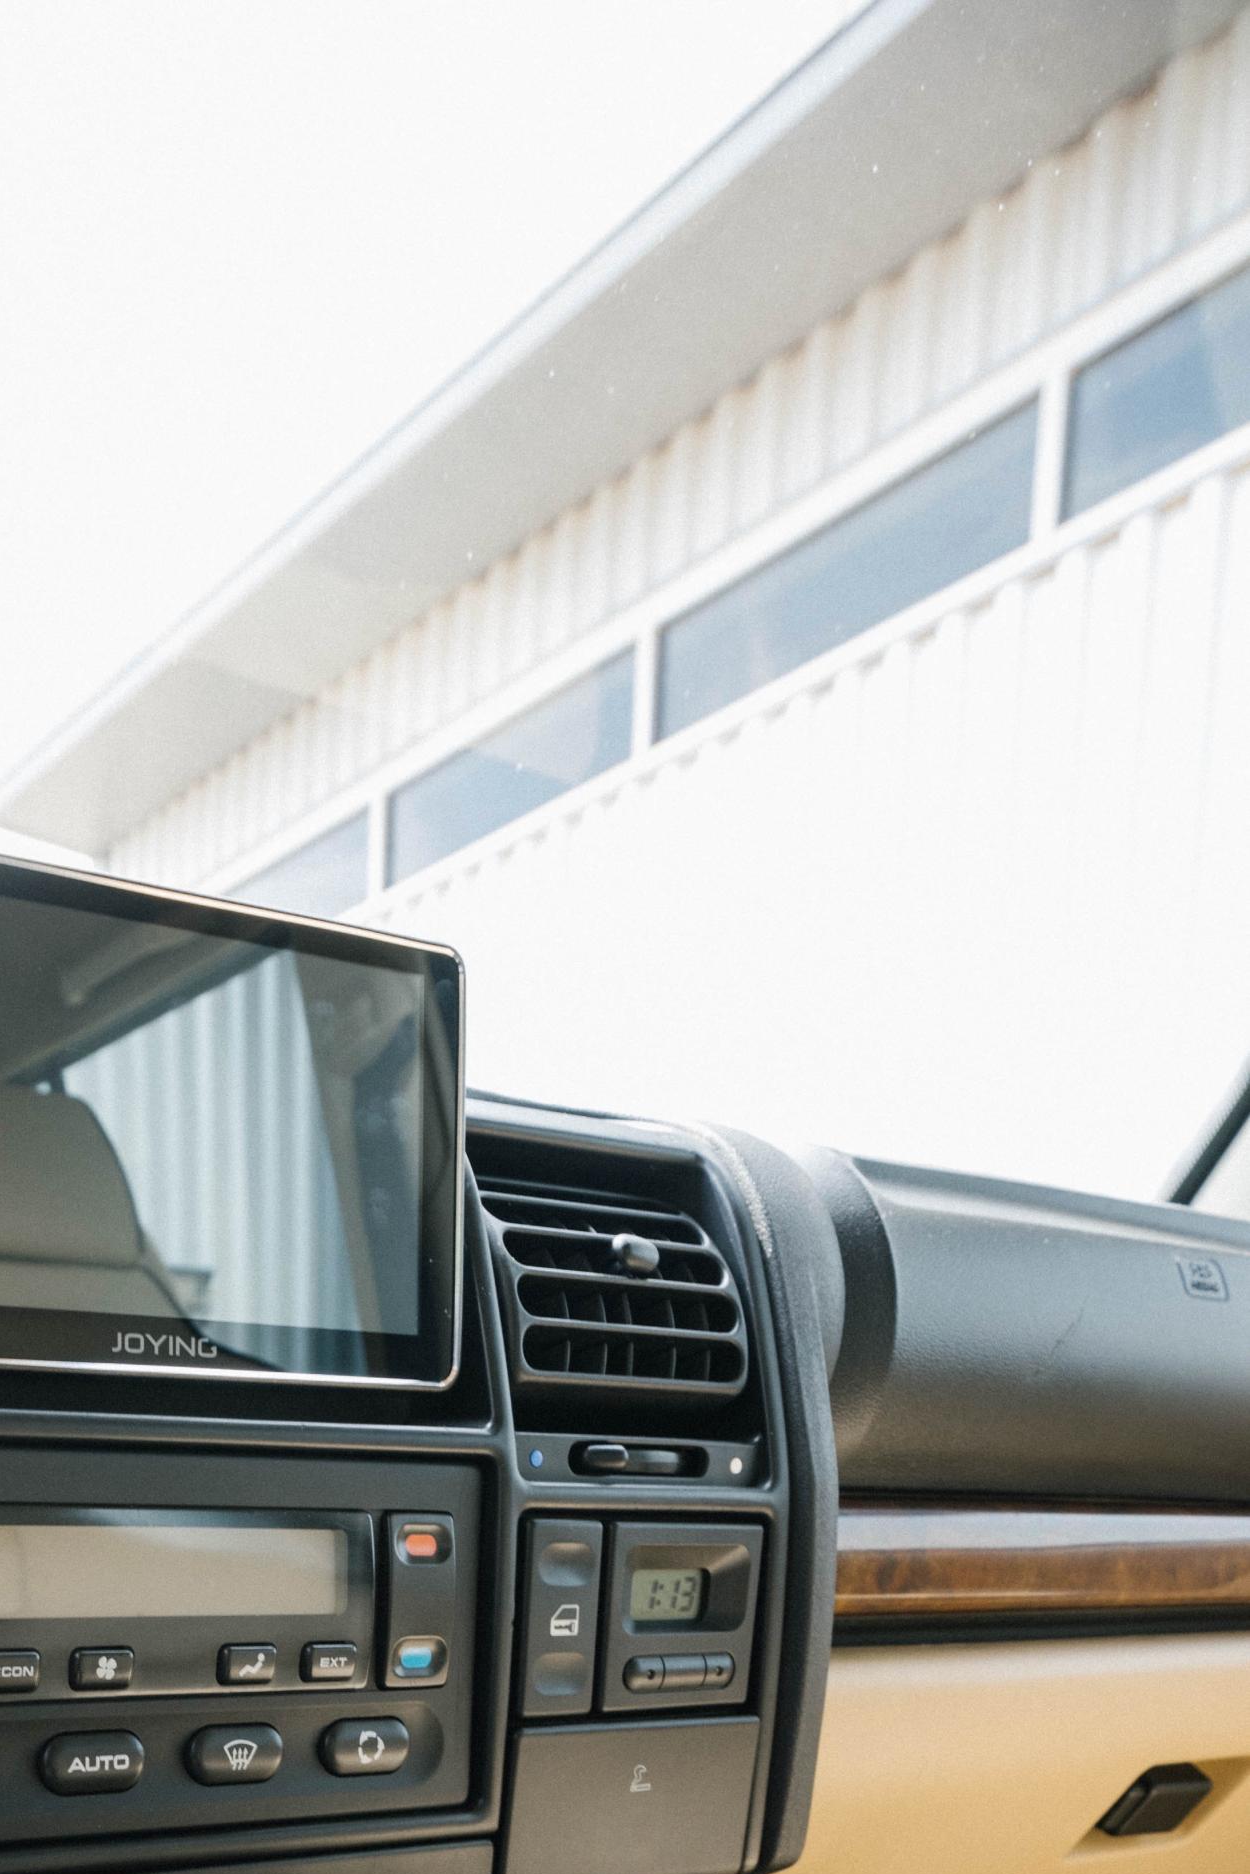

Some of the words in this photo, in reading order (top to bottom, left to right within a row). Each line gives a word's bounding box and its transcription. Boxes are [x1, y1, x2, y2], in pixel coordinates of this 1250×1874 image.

[111, 1331, 217, 1359] JOYING
[648, 1576, 697, 1613] 1:13
[318, 1655, 348, 1669] EXT
[67, 1753, 131, 1774] AUTO
